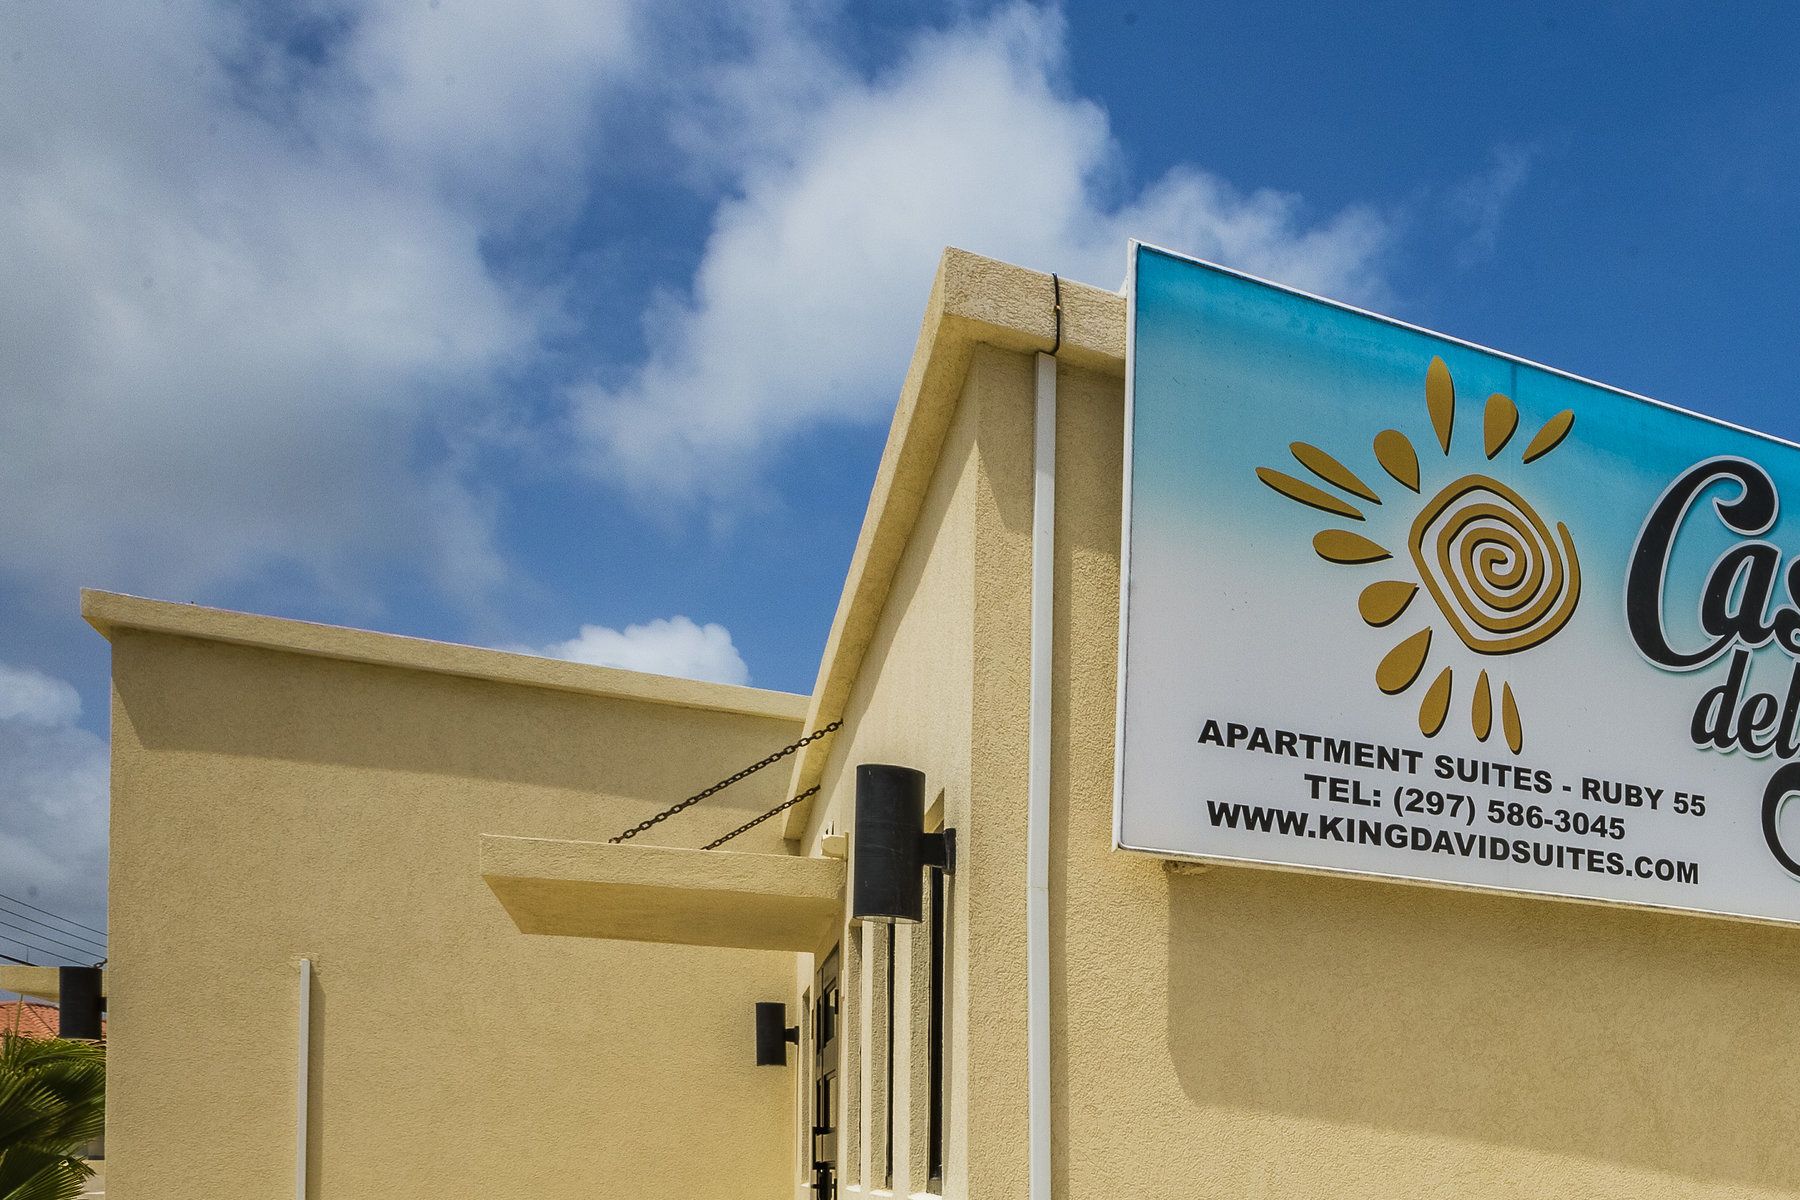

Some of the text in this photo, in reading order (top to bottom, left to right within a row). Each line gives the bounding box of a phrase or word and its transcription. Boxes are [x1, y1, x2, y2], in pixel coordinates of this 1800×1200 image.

[1197, 719, 1423, 775] APARTMENT
[1434, 754, 1553, 794] SUITES
[1582, 777, 1664, 810] RUBY
[1673, 791, 1706, 817] 55
[1304, 773, 1626, 840] TEL: (297) 586-3045
[1206, 800, 1699, 885] WWW.KINGDAVIDSUITES.COM
